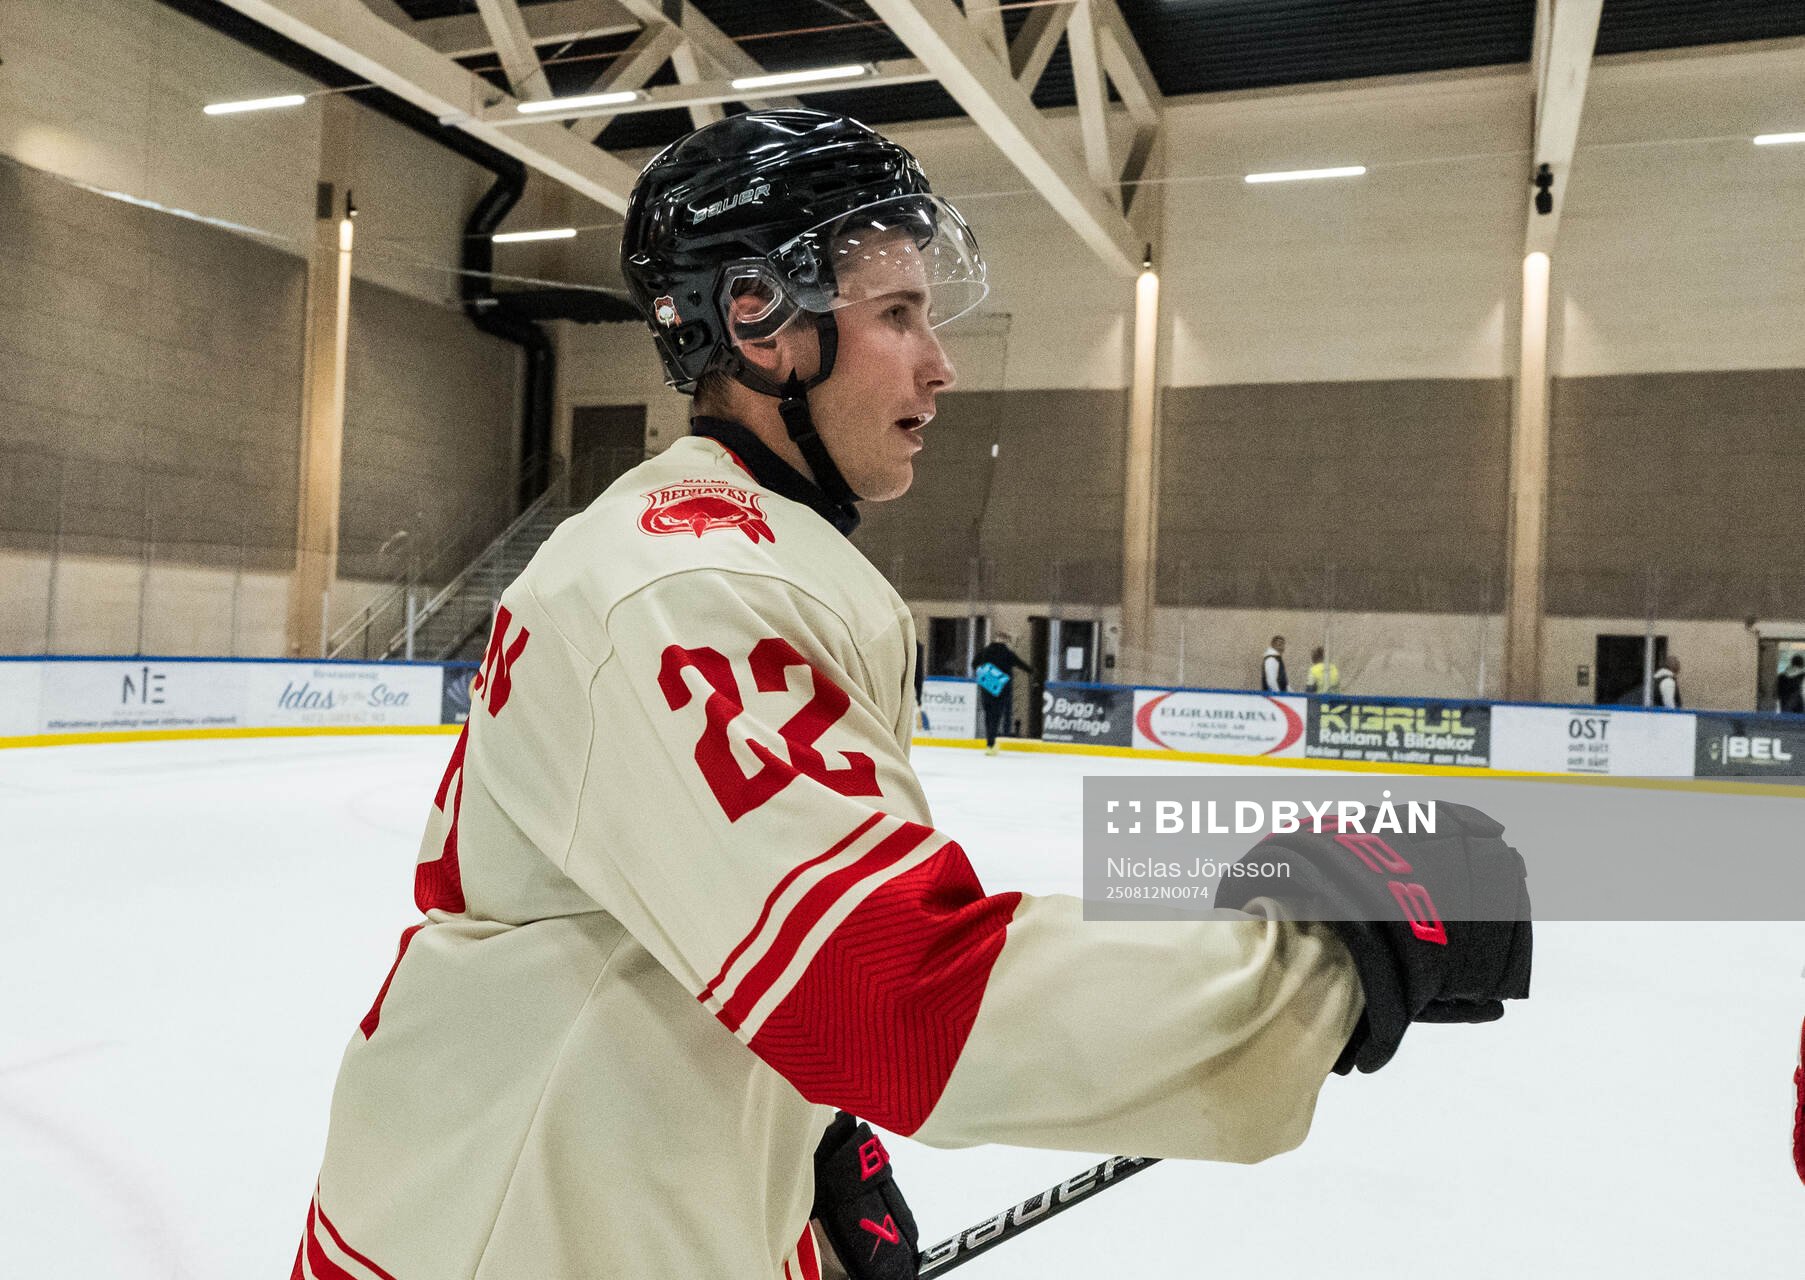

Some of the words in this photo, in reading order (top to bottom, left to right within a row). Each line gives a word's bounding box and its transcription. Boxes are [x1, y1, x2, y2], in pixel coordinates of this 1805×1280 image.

[660, 487, 748, 505] REDHAWKS
[474, 604, 530, 718] N
[278, 681, 335, 709] Idas
[368, 683, 409, 707] Sea
[1054, 698, 1094, 718] Bygg
[657, 637, 884, 823] 22
[1044, 715, 1111, 736] Montage
[1569, 718, 1609, 740] OST
[1319, 729, 1382, 746] Reklam
[1386, 731, 1399, 747] &
[1403, 732, 1475, 751] Bildekor
[1729, 736, 1792, 760] BEL
